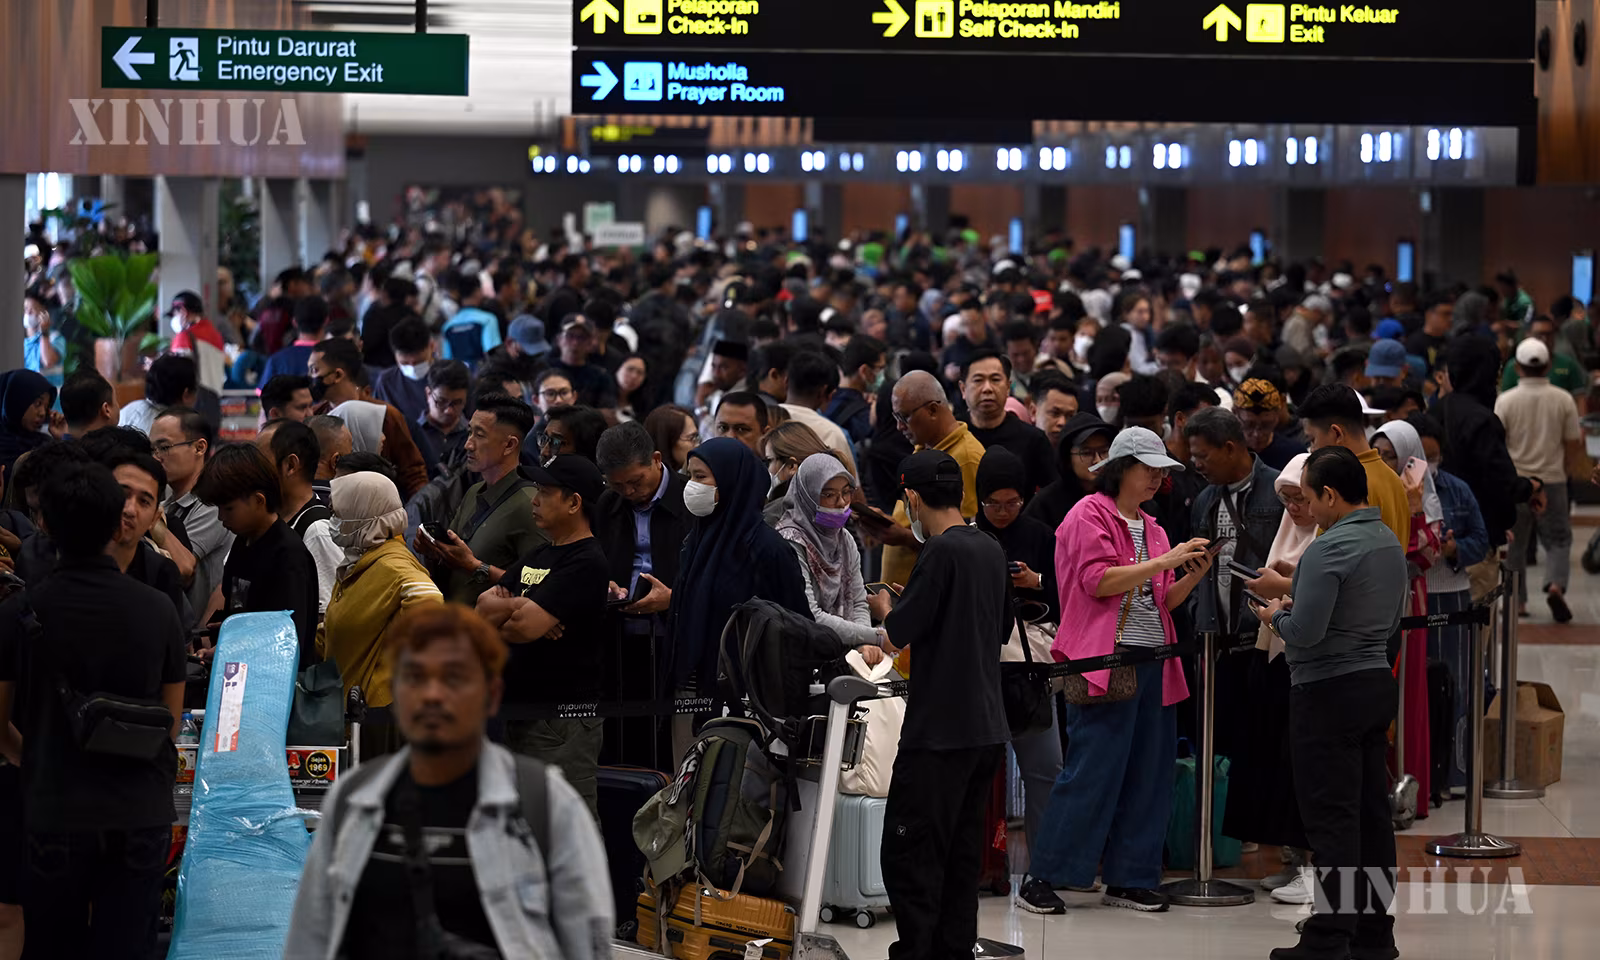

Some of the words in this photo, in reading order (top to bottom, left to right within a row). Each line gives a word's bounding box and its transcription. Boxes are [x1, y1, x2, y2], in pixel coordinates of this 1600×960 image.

[668, 0, 759, 18] Pelaporan
[959, 0, 1050, 20] Pelaporan
[1054, 1, 1120, 19] Mandiri
[1290, 4, 1336, 22] Pintu
[1341, 5, 1399, 23] Keluar
[667, 15, 749, 35] Check-In
[959, 18, 996, 37] Self
[998, 19, 1079, 38] Check-In
[1290, 24, 1325, 42] Exit
[217, 37, 270, 56] Pintu
[277, 37, 357, 58] Darurat
[218, 61, 338, 85] Emergency
[344, 63, 384, 83] Exit
[667, 61, 748, 81] Musholla
[667, 82, 728, 105] Prayer
[730, 83, 784, 101] Room
[676, 706, 712, 714] AIRPORTS
[309, 763, 328, 771] 1969
